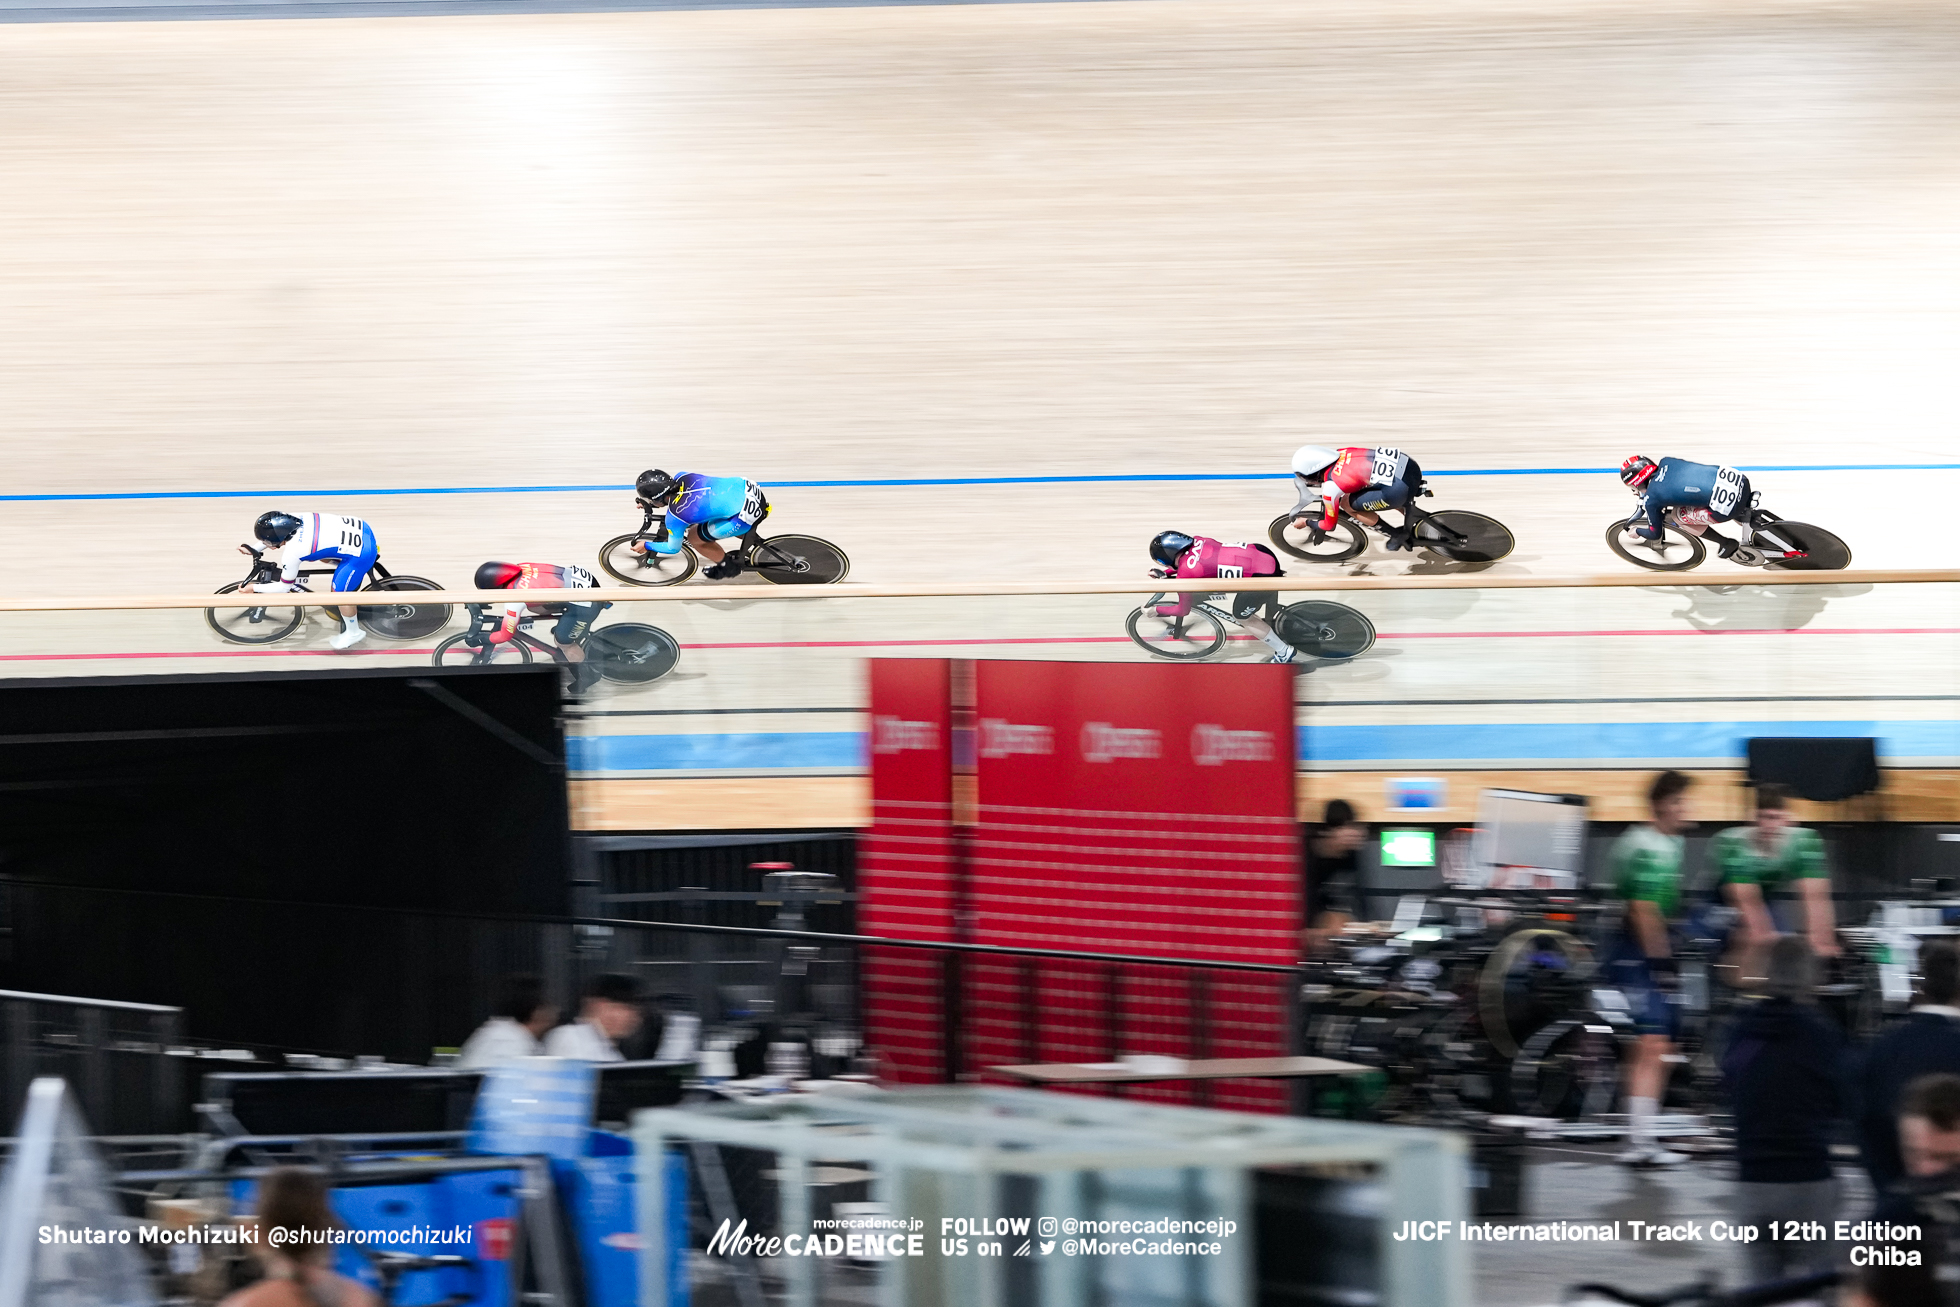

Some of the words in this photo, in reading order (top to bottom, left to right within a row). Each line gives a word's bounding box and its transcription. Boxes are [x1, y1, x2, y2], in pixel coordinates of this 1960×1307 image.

[1334, 449, 1347, 477] CHINA
[1372, 460, 1395, 478] 103
[1362, 499, 1391, 512] CHINA
[1712, 486, 1736, 508] 109
[742, 498, 761, 518] 106
[341, 530, 362, 548] 110
